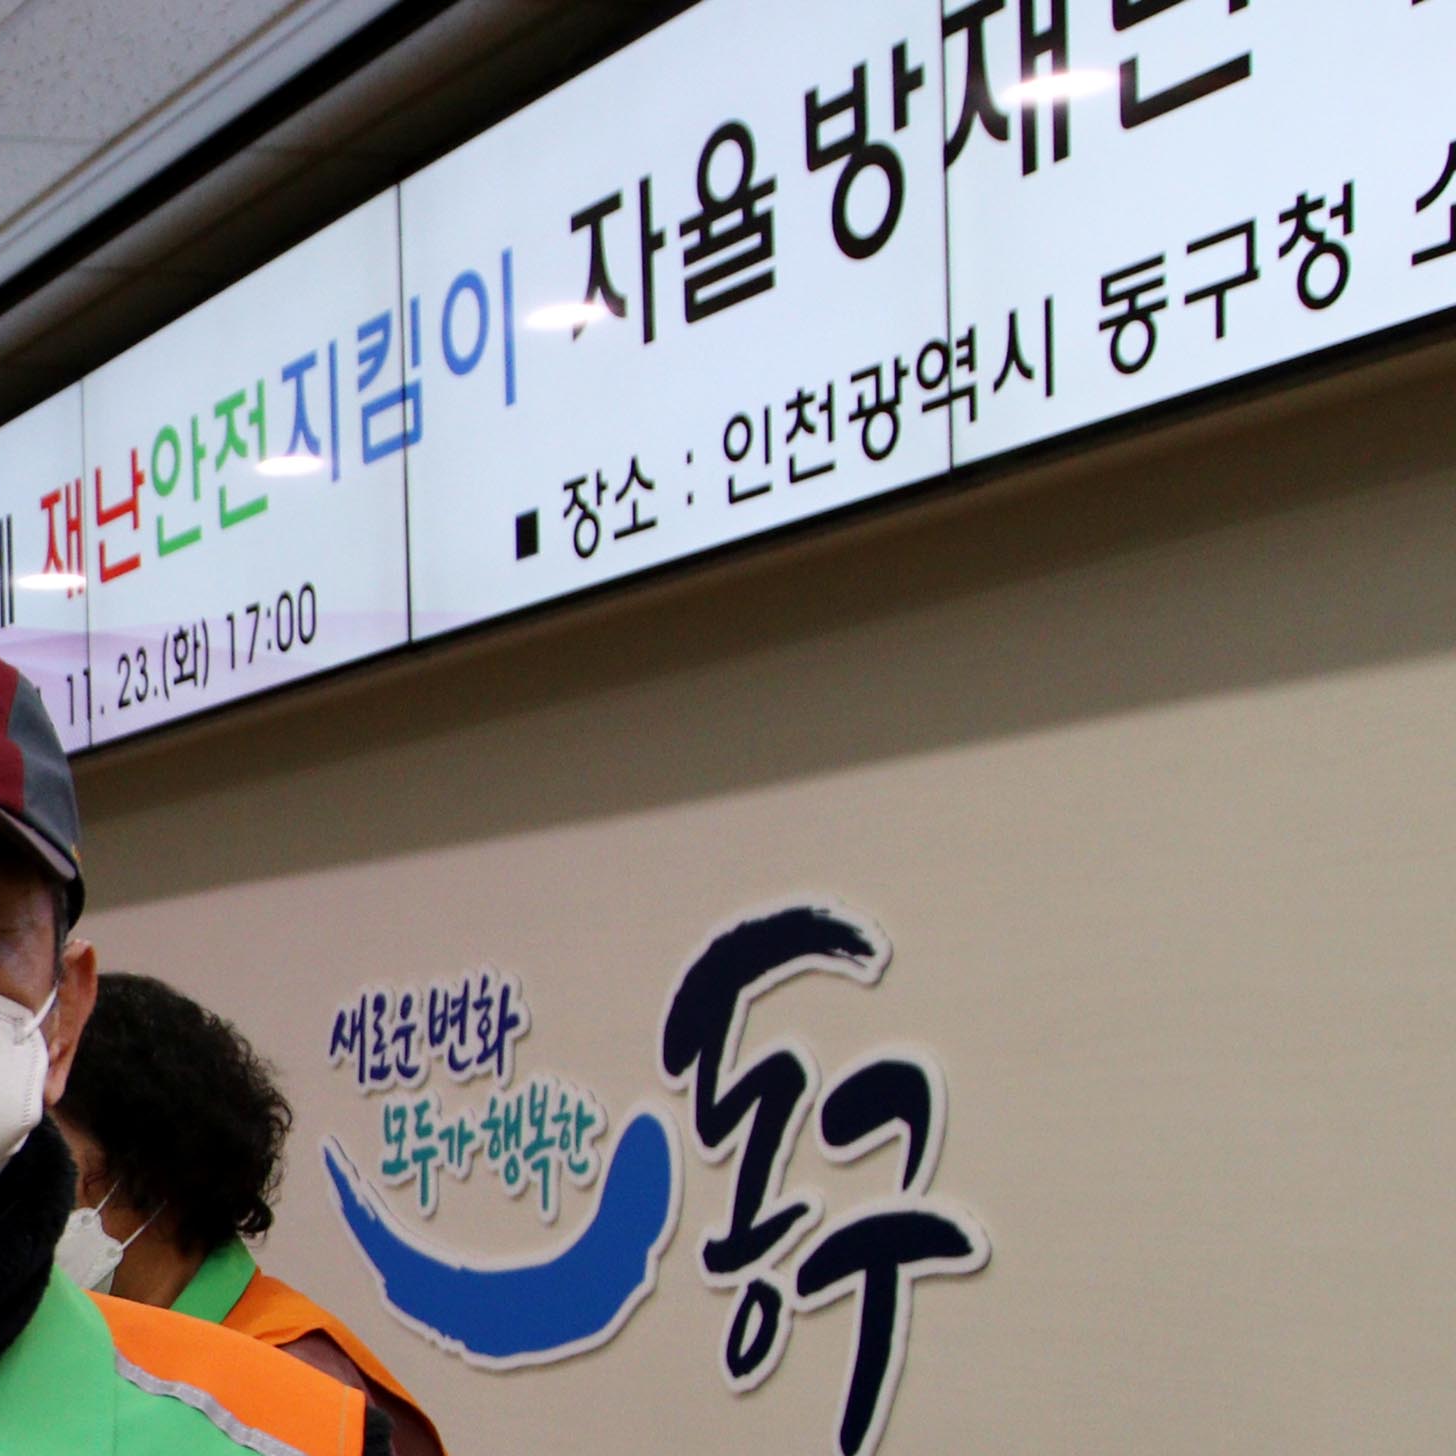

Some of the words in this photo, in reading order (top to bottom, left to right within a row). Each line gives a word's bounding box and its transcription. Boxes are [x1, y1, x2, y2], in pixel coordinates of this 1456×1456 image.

[39, 246, 518, 599] 재난안전지킴이
[561, 455, 658, 562] 장소
[722, 295, 1057, 507] 인천광역시
[1097, 180, 1357, 377] 동구청
[224, 582, 319, 672] 17:00
[328, 991, 423, 1084] 새로운
[427, 974, 524, 1080] 변화
[381, 1095, 476, 1209] 모두가
[480, 1080, 599, 1212] 행복한
